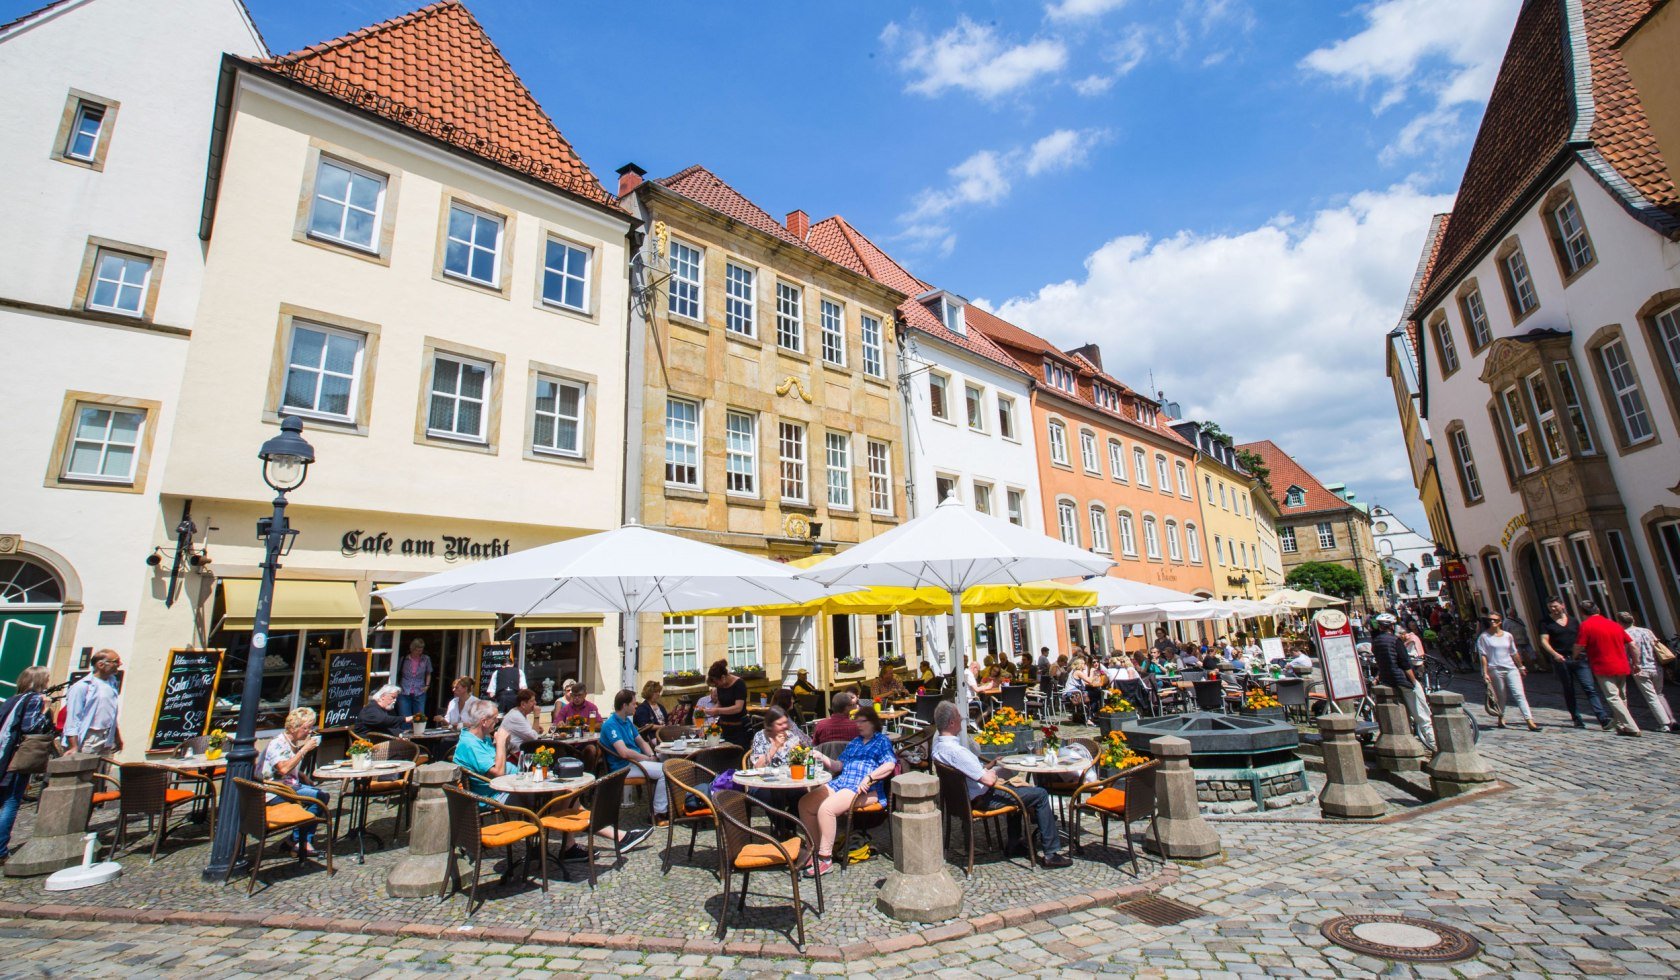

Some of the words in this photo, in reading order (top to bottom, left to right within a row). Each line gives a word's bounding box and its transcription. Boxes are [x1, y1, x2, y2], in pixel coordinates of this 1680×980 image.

[341, 530, 393, 557] Cafe
[401, 536, 435, 556] am
[442, 535, 510, 562] Markt
